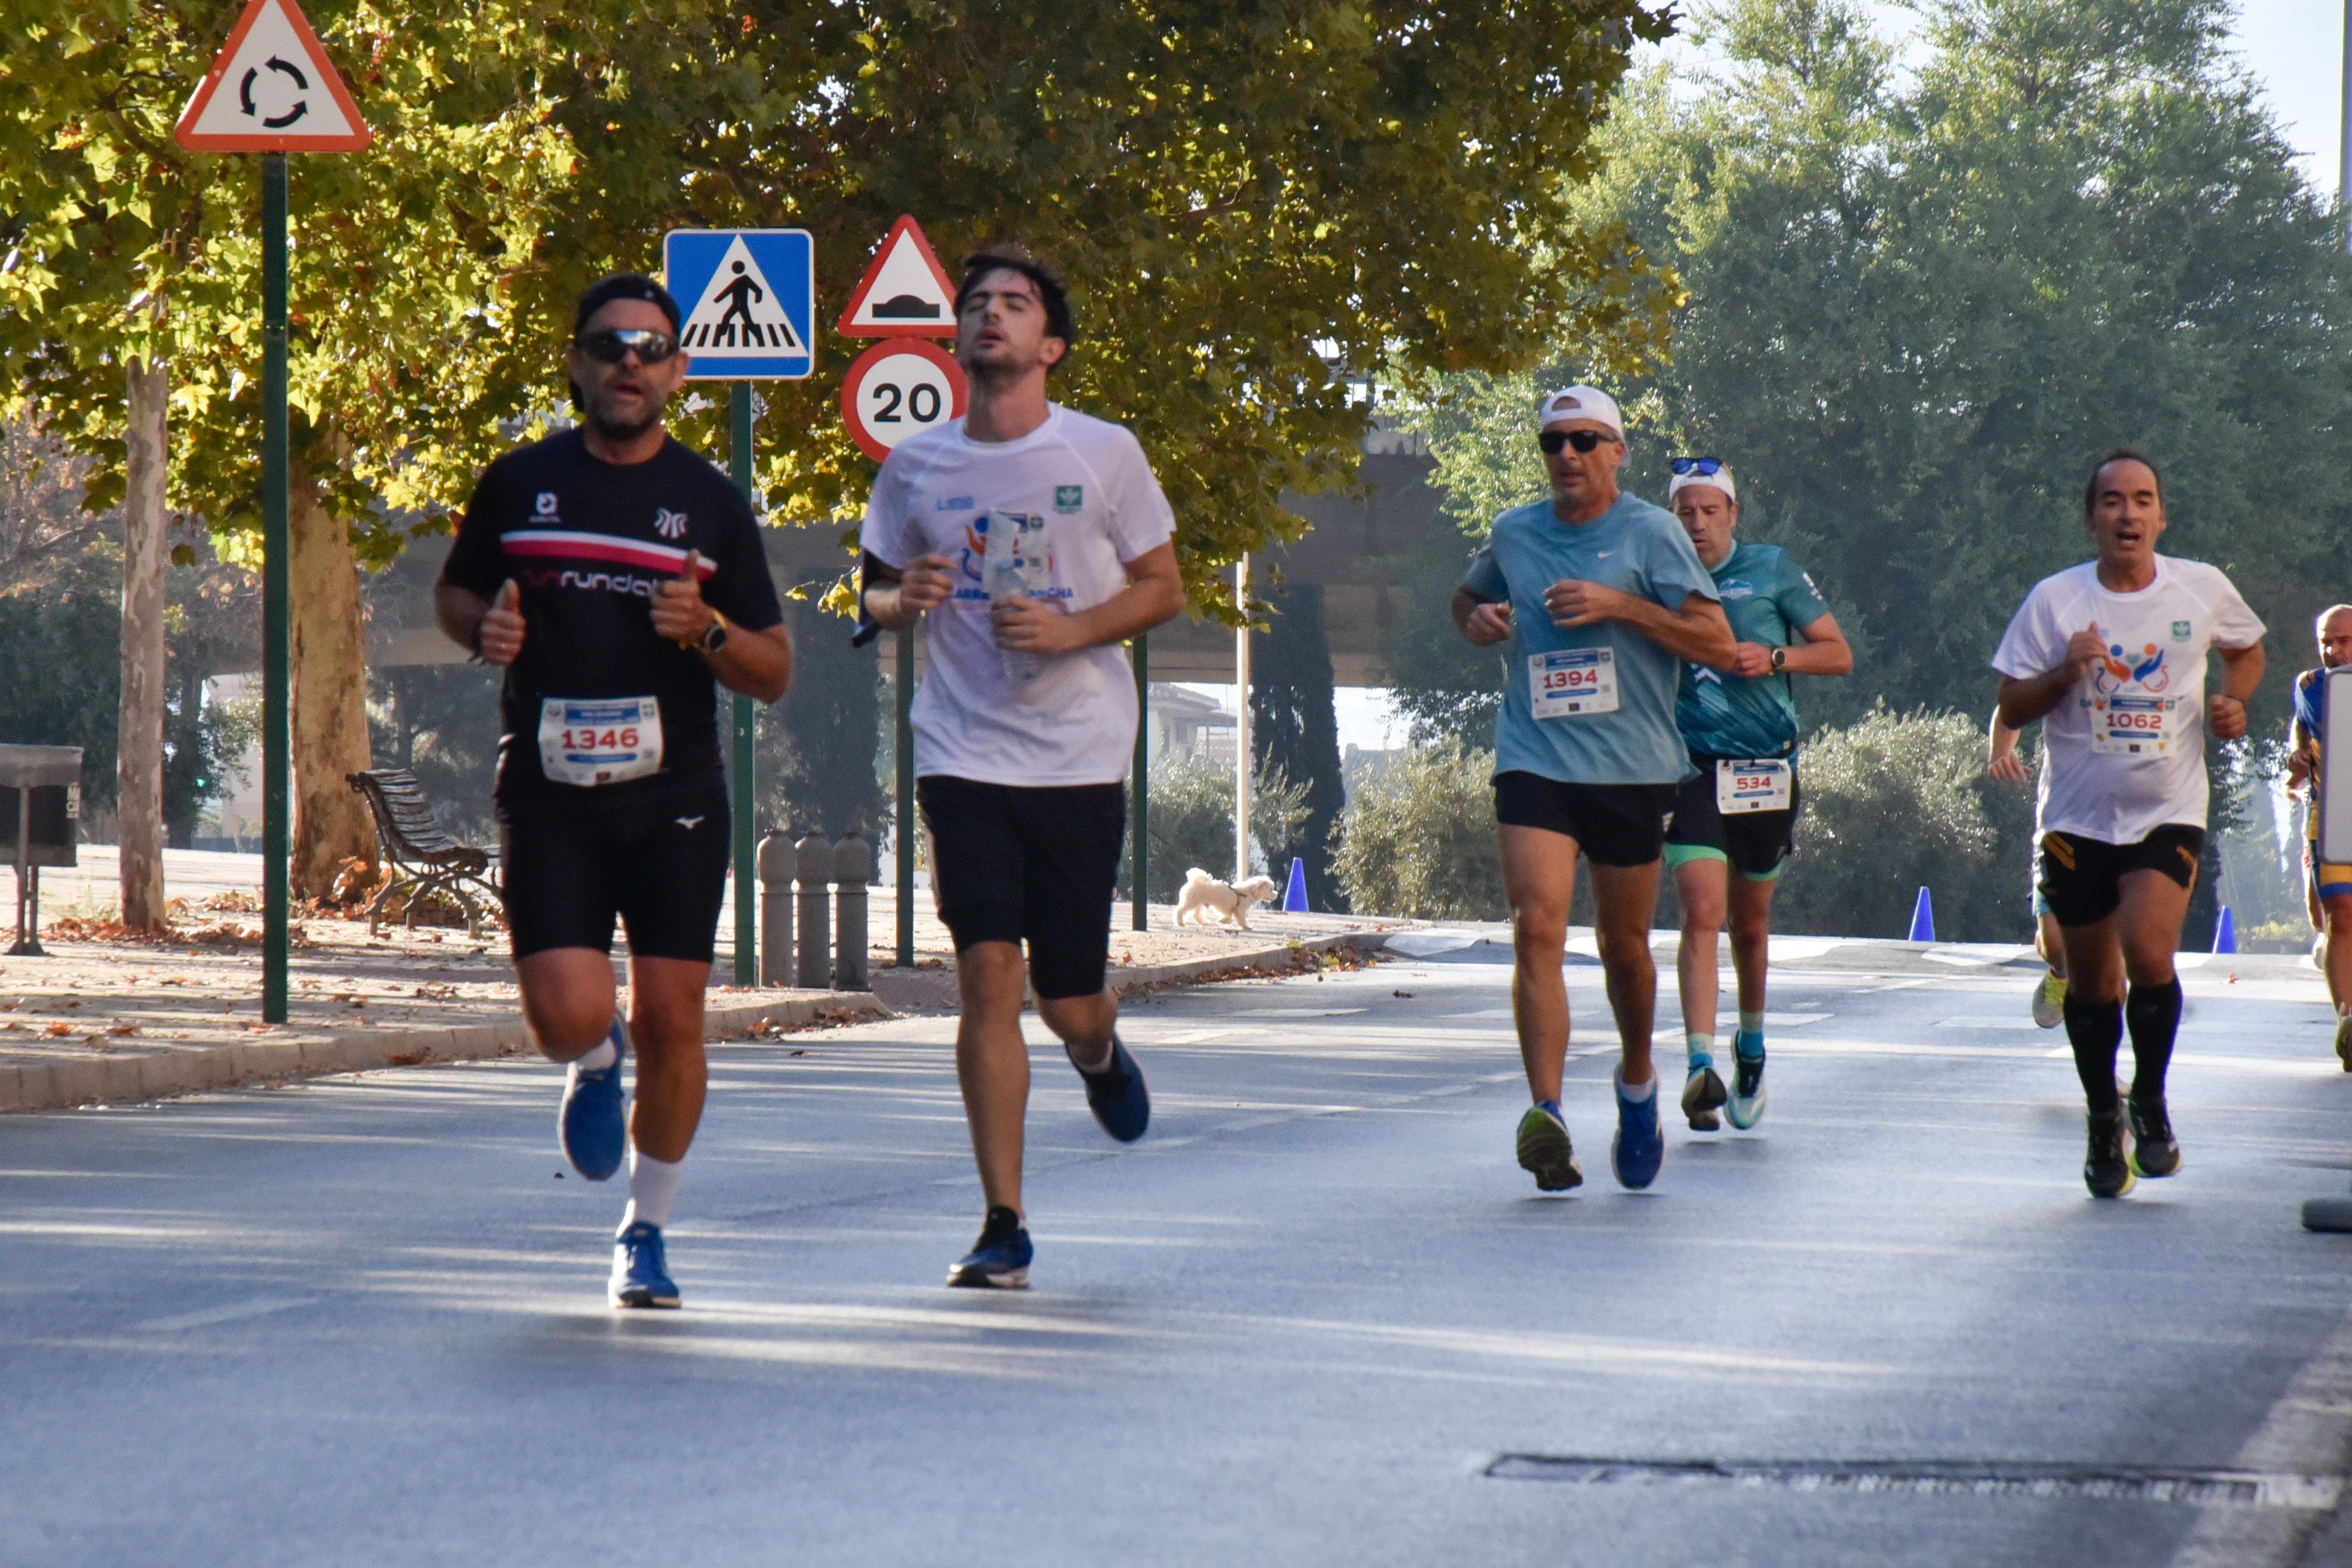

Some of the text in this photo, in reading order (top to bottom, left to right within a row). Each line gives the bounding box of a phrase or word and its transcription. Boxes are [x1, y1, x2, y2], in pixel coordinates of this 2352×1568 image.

[873, 383, 941, 422] 20
[1544, 669, 1597, 689] 1394
[2107, 713, 2162, 729] 1062
[561, 727, 639, 749] 1346
[1737, 776, 1771, 789] 534
